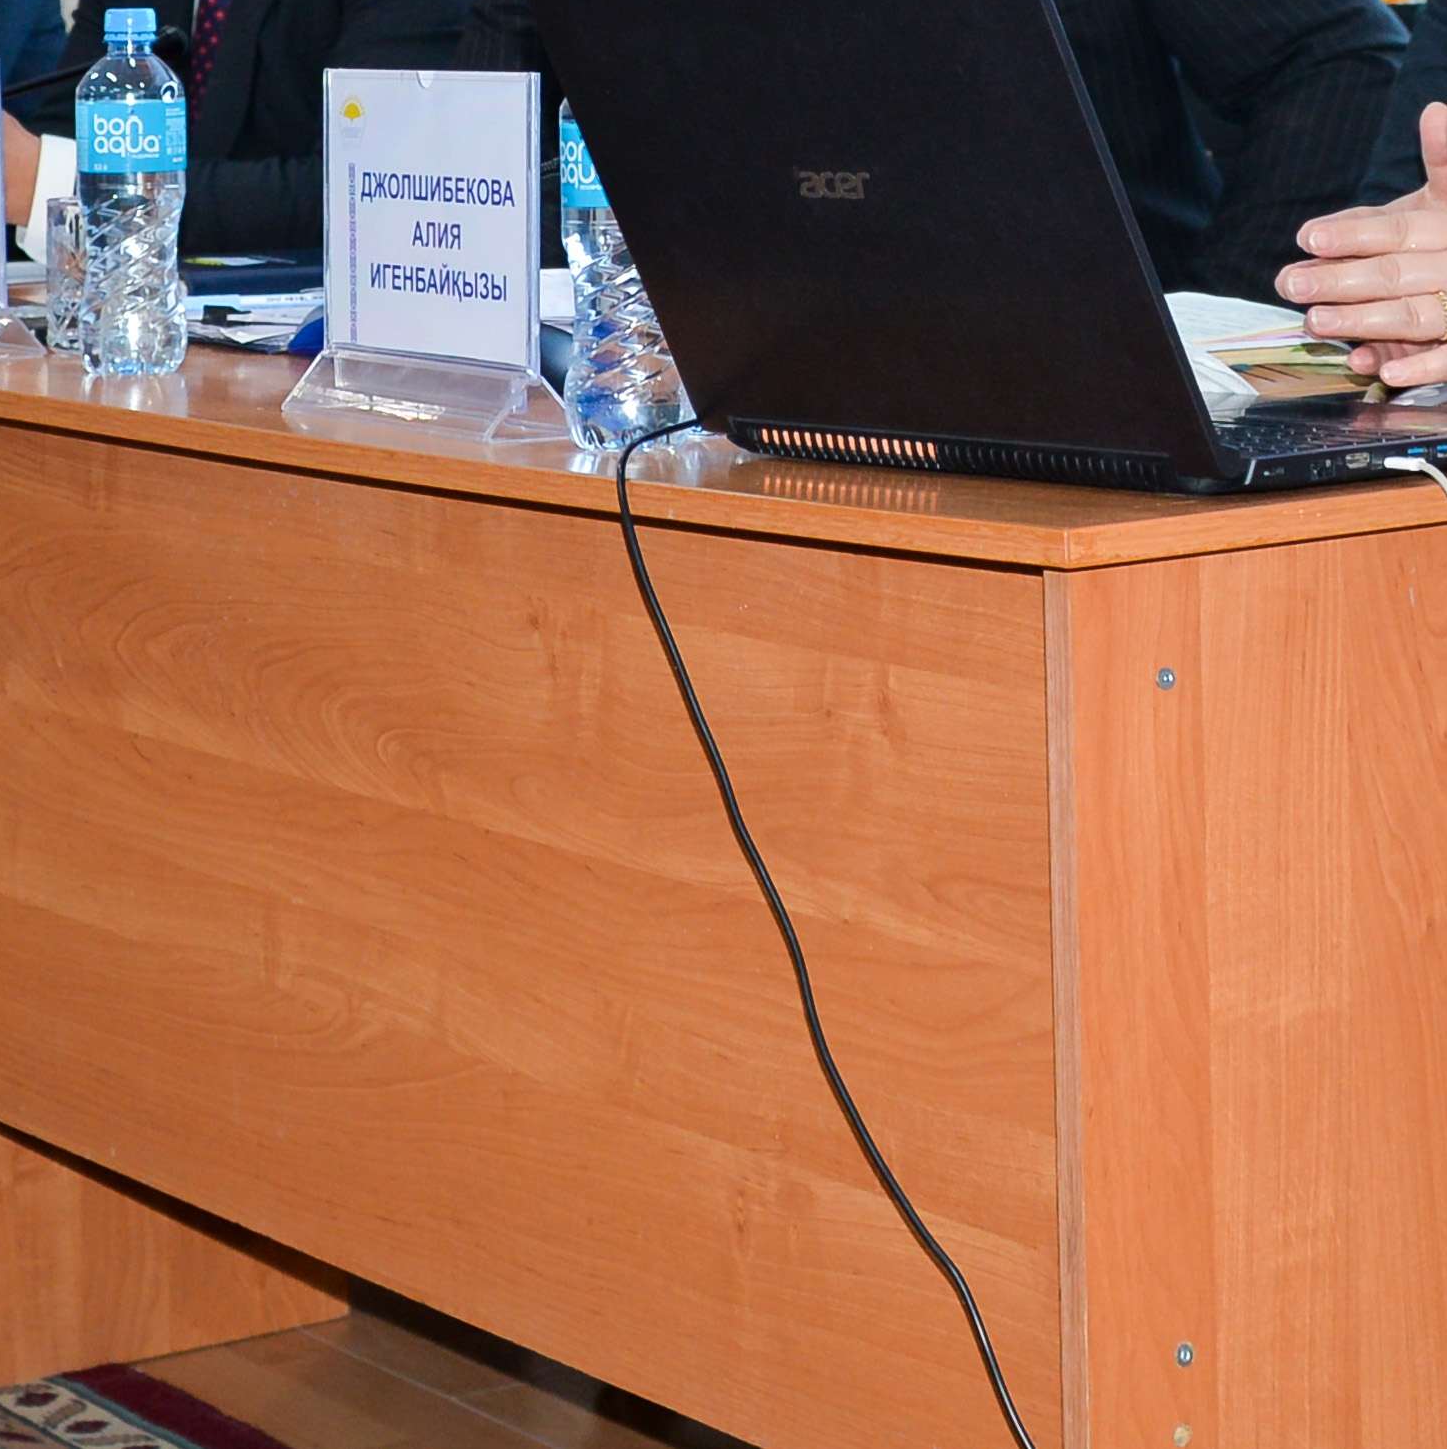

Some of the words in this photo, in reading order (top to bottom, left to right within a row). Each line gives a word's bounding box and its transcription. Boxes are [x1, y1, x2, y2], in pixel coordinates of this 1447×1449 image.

[93, 113, 143, 136] bon
[93, 135, 160, 159] aqua
[360, 171, 515, 208] ДЖОЛШИБЕКОВА
[798, 171, 870, 199] acer
[411, 220, 462, 251] АЛИЯ
[369, 261, 508, 303] ИГЕНБАЙҚЫЗЫ
